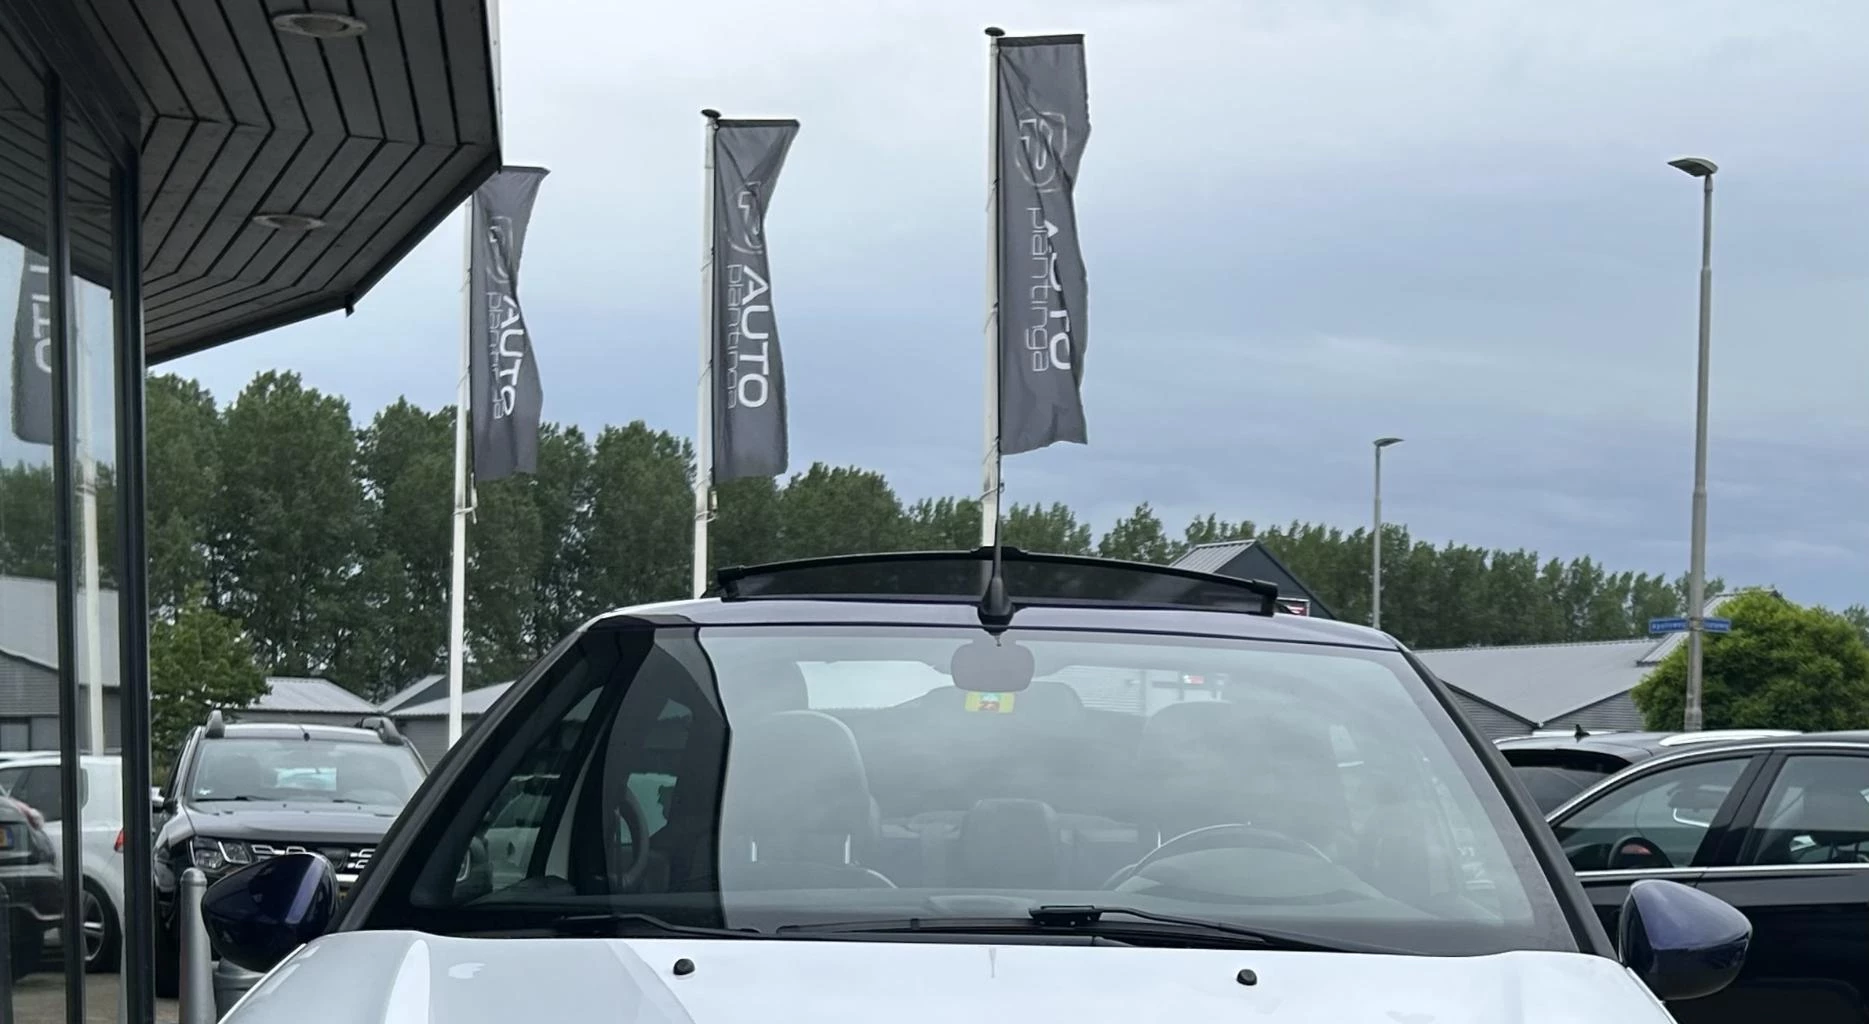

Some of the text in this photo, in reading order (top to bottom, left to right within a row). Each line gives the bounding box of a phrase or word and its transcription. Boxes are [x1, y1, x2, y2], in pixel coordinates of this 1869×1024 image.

[499, 295, 525, 416] AUTO
[738, 265, 770, 408] AUTO
[1024, 207, 1050, 372] plantinga
